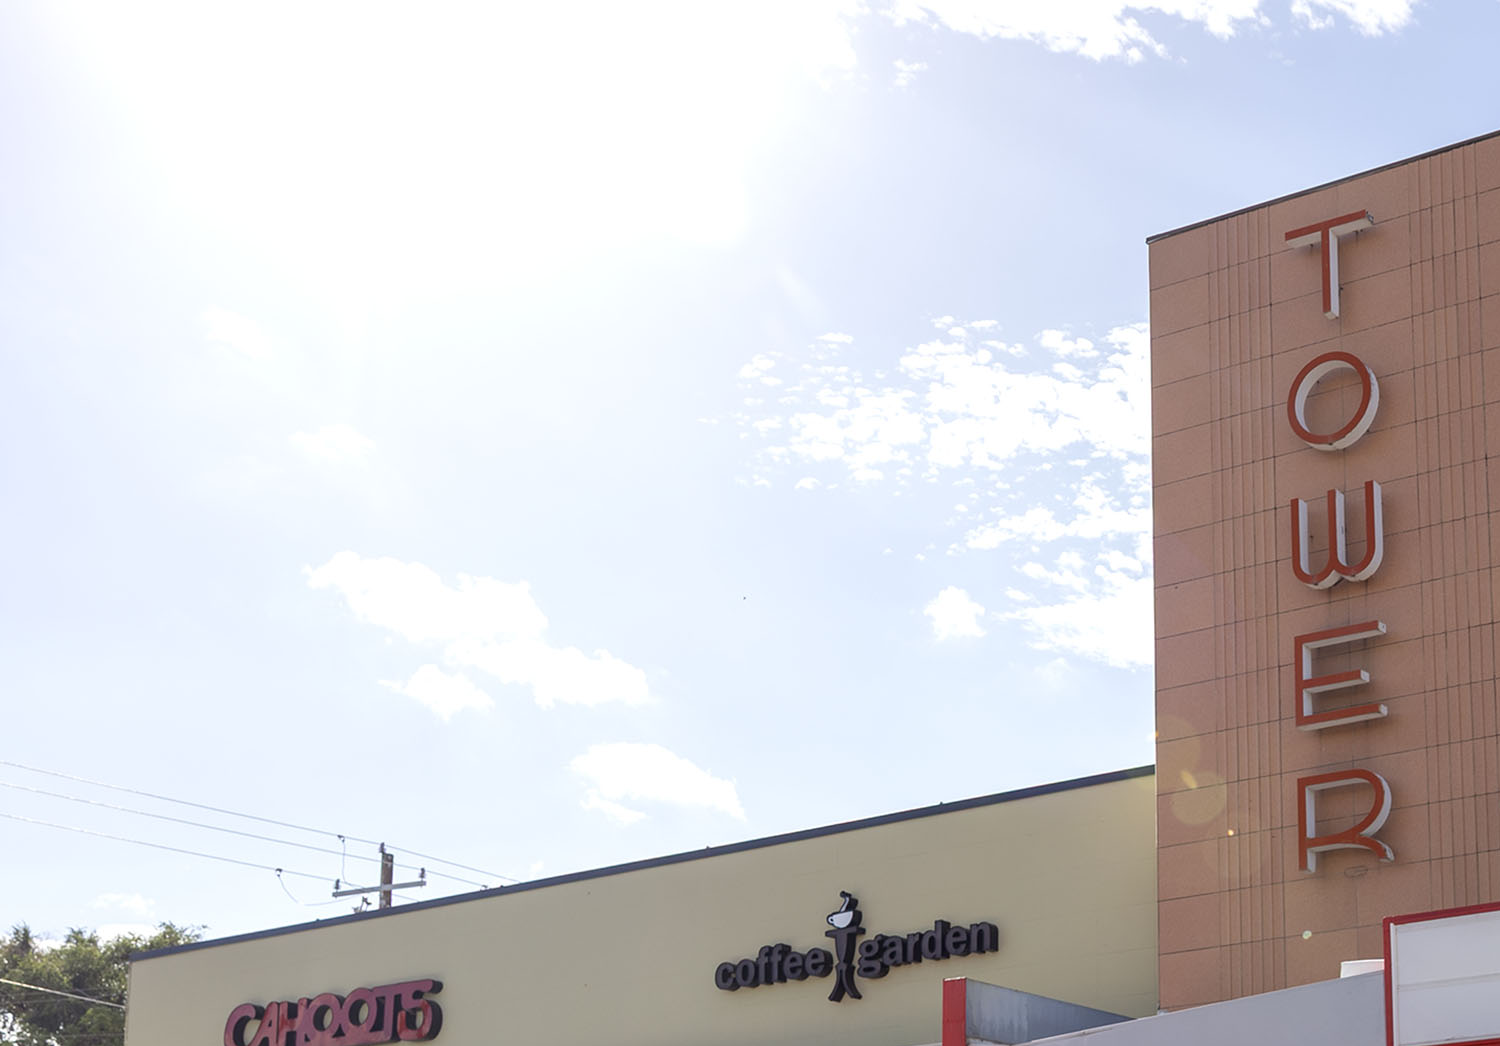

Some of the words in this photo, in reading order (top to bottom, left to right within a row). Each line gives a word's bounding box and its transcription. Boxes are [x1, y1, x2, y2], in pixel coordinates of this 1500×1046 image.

[1284, 209, 1395, 873] TOWER
[714, 942, 834, 991] coffee
[856, 919, 1000, 979] garden
